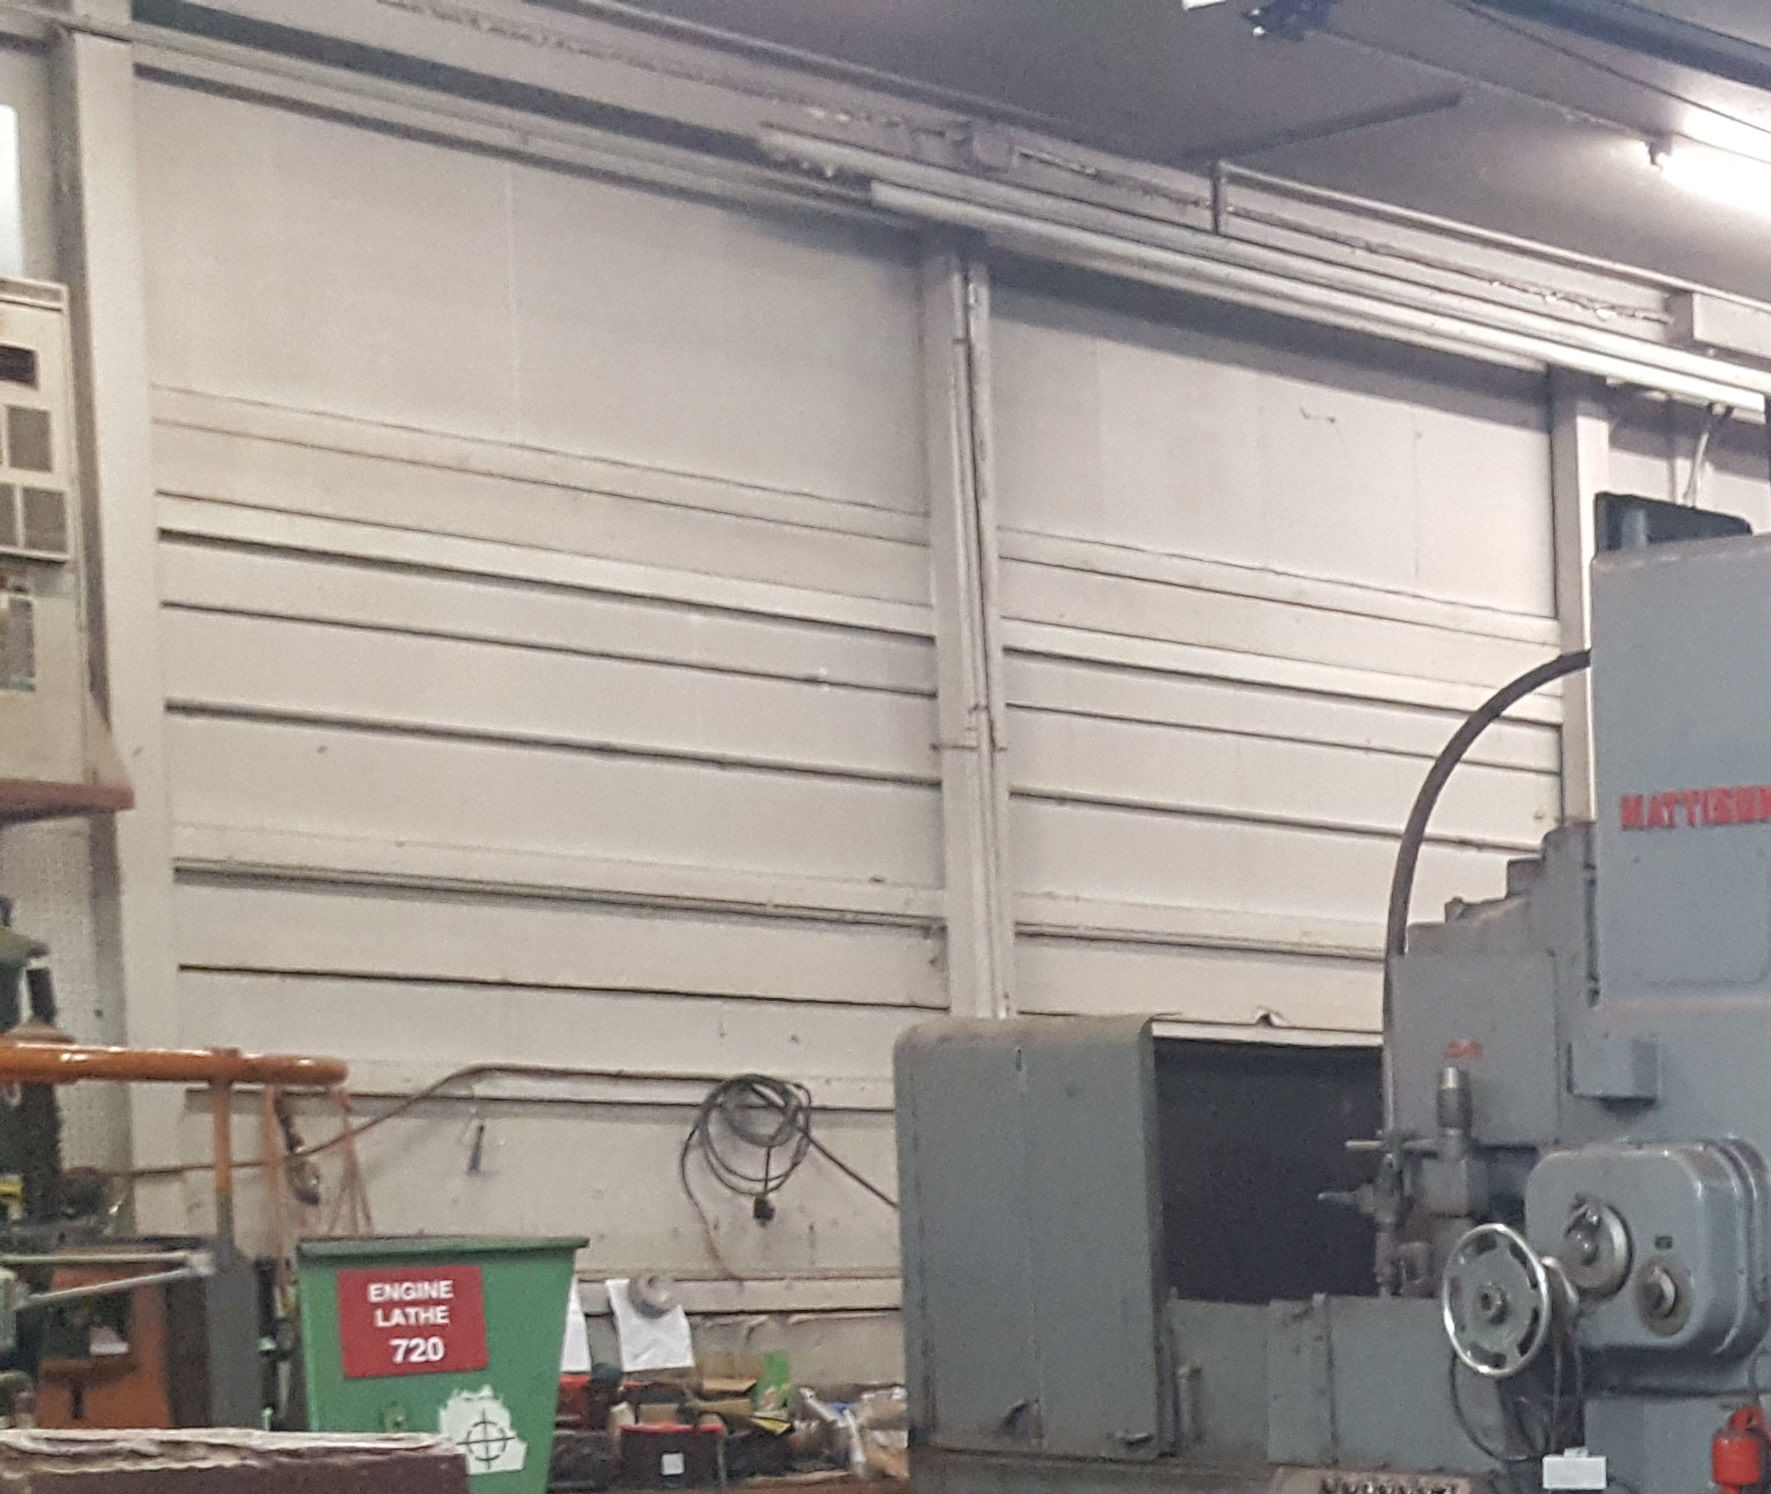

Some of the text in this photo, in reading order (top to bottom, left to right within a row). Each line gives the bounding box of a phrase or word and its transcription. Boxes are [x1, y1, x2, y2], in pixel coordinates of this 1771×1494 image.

[367, 1280, 454, 1303] ENGINE
[374, 1305, 451, 1328] LATHE
[389, 1336, 445, 1363] 720
